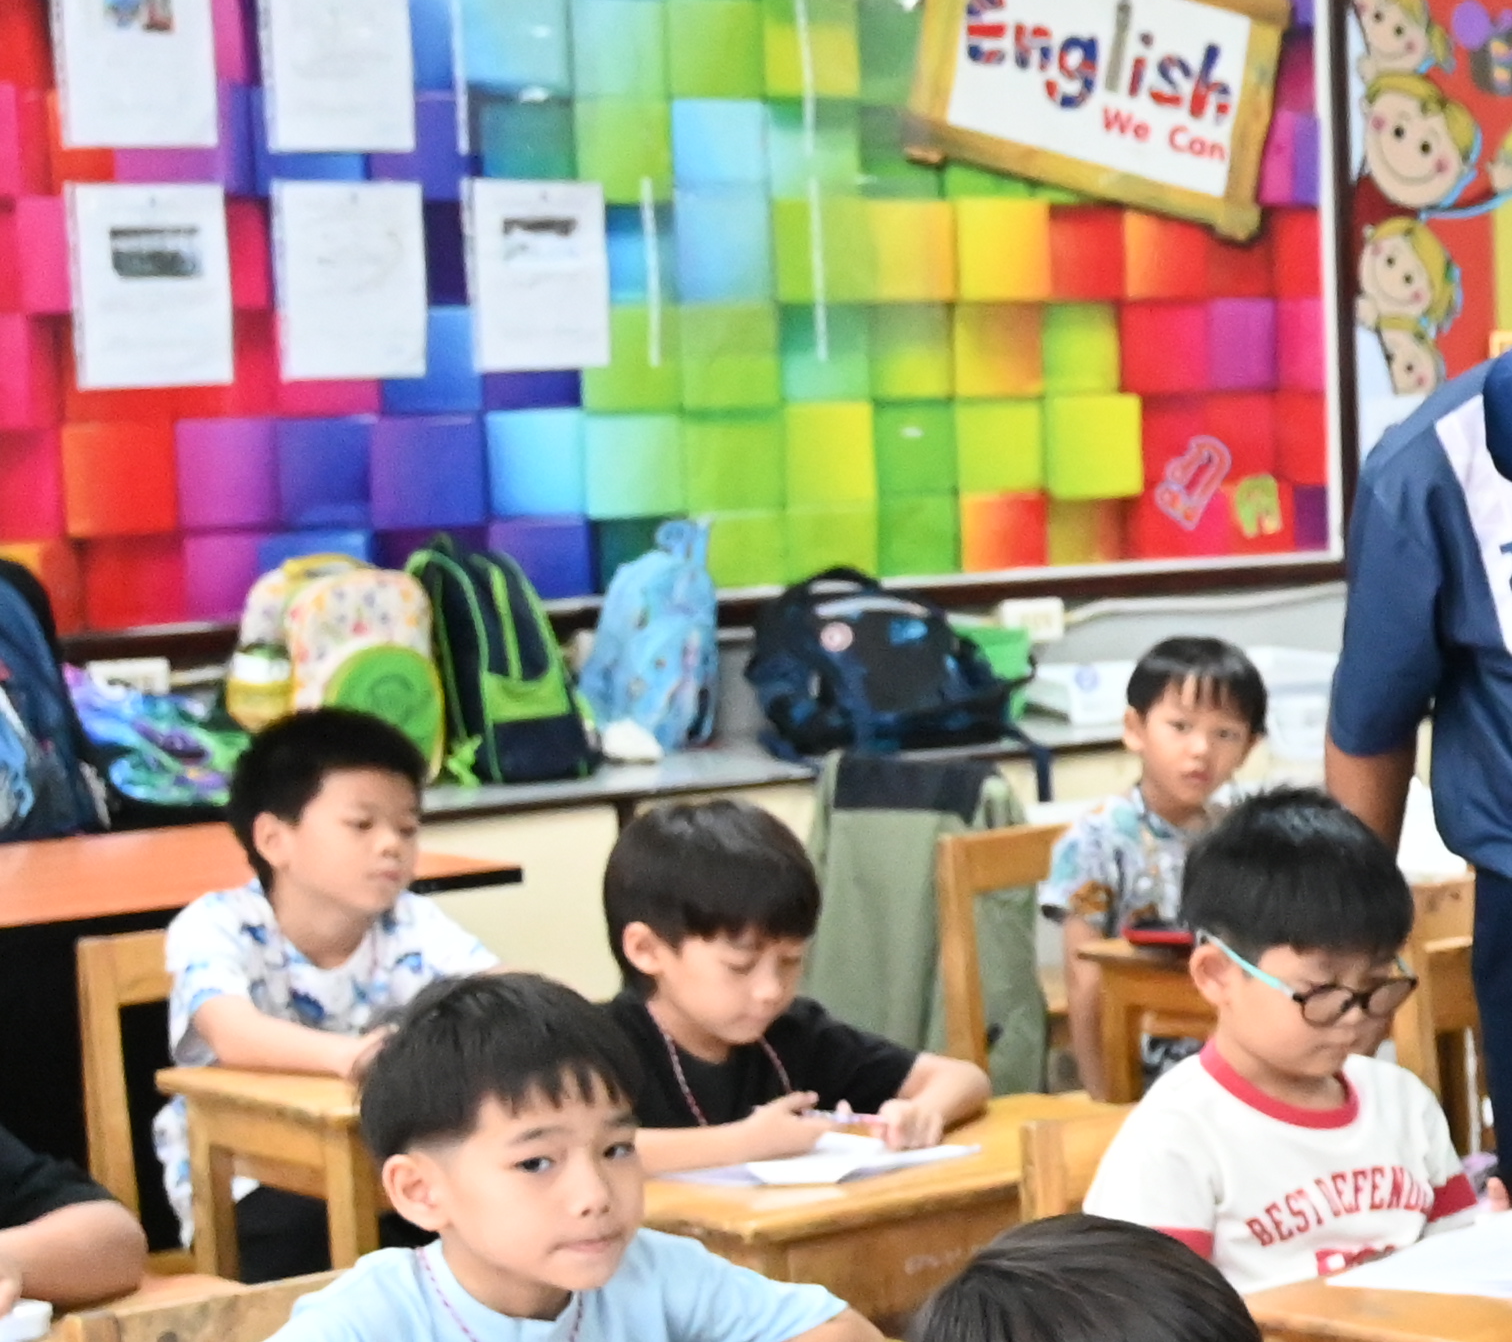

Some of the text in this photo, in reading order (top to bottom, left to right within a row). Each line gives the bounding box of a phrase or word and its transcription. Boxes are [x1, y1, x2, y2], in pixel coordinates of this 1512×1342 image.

[1103, 106, 1226, 161] We Can
[1245, 1187, 1325, 1247] BEST
